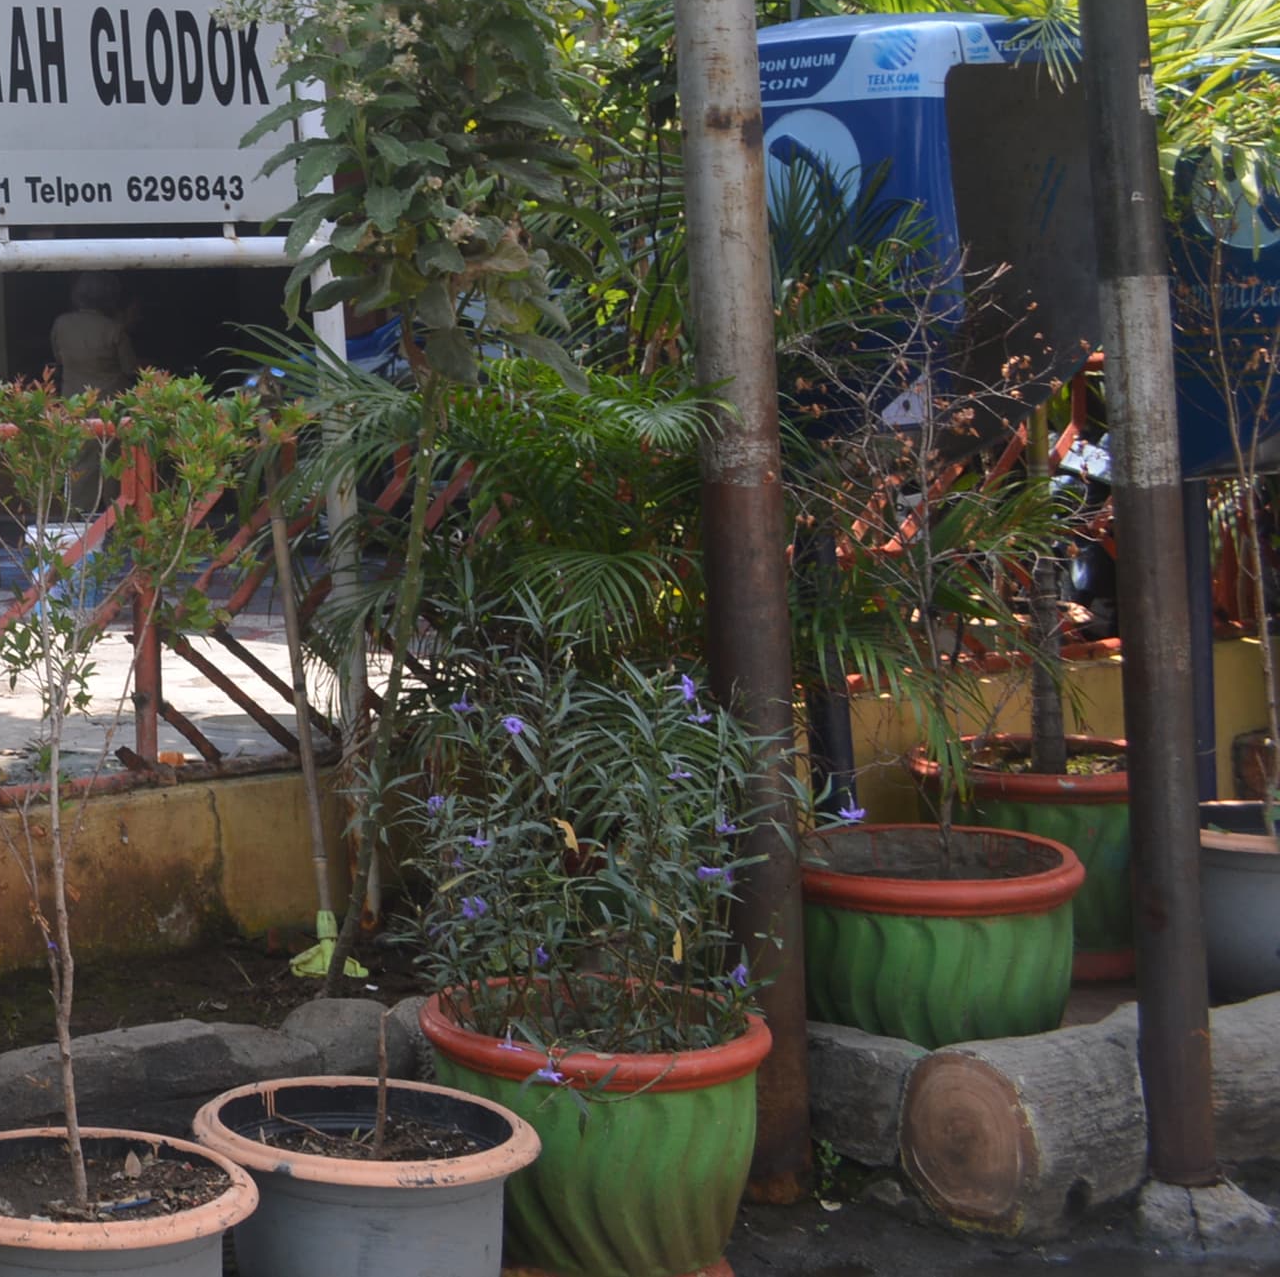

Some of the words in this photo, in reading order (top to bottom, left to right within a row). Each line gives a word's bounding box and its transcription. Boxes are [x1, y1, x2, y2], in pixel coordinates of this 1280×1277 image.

[90, 6, 271, 107] GLODOK
[790, 52, 836, 70] UMUM
[867, 73, 920, 85] TELKOM
[25, 175, 113, 207] Telpon
[126, 174, 245, 203] 6296843
